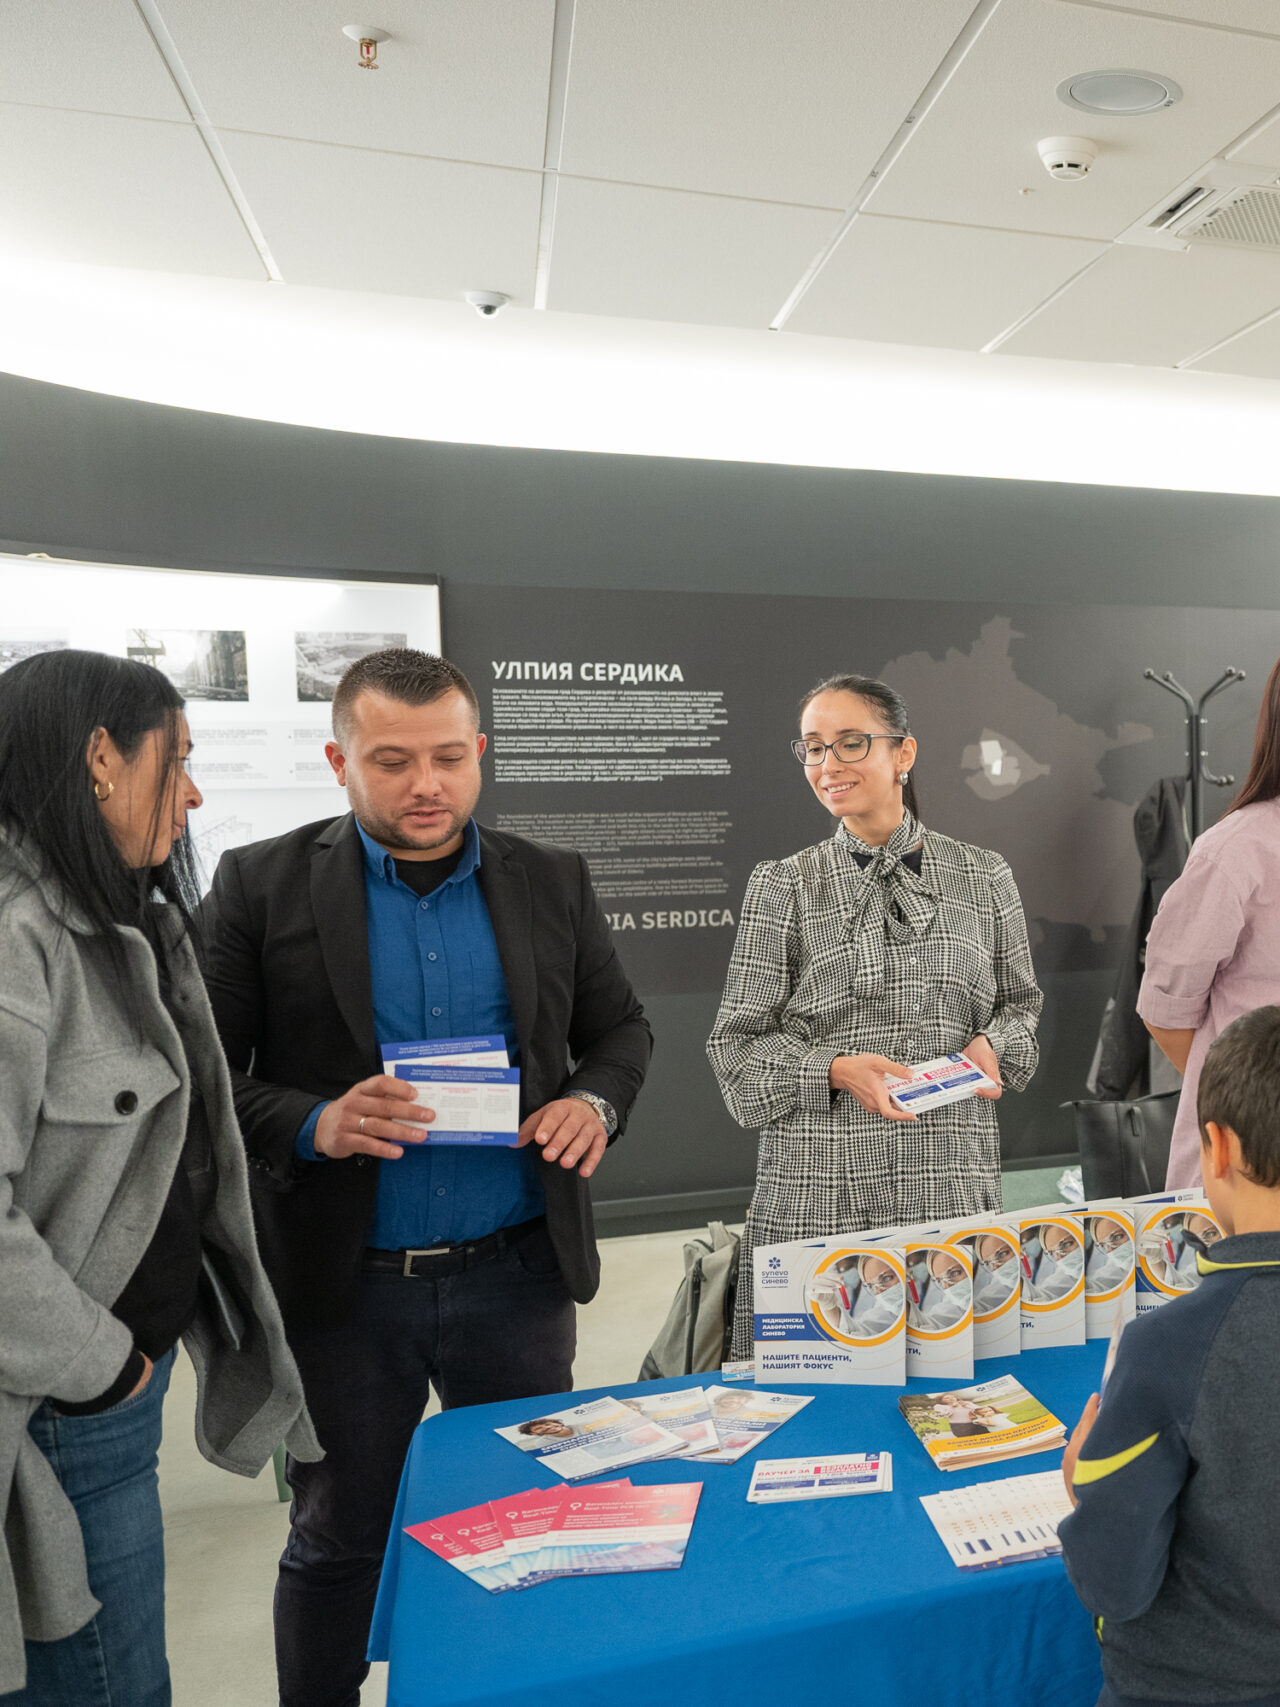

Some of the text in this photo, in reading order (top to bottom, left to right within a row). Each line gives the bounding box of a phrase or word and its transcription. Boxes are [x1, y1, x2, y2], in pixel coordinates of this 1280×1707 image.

[491, 661, 685, 685] УЛПИЯ СЕРДИКА
[642, 909, 735, 929] SERDICA
[802, 1354, 852, 1363] ПАЦИЕНТИ,
